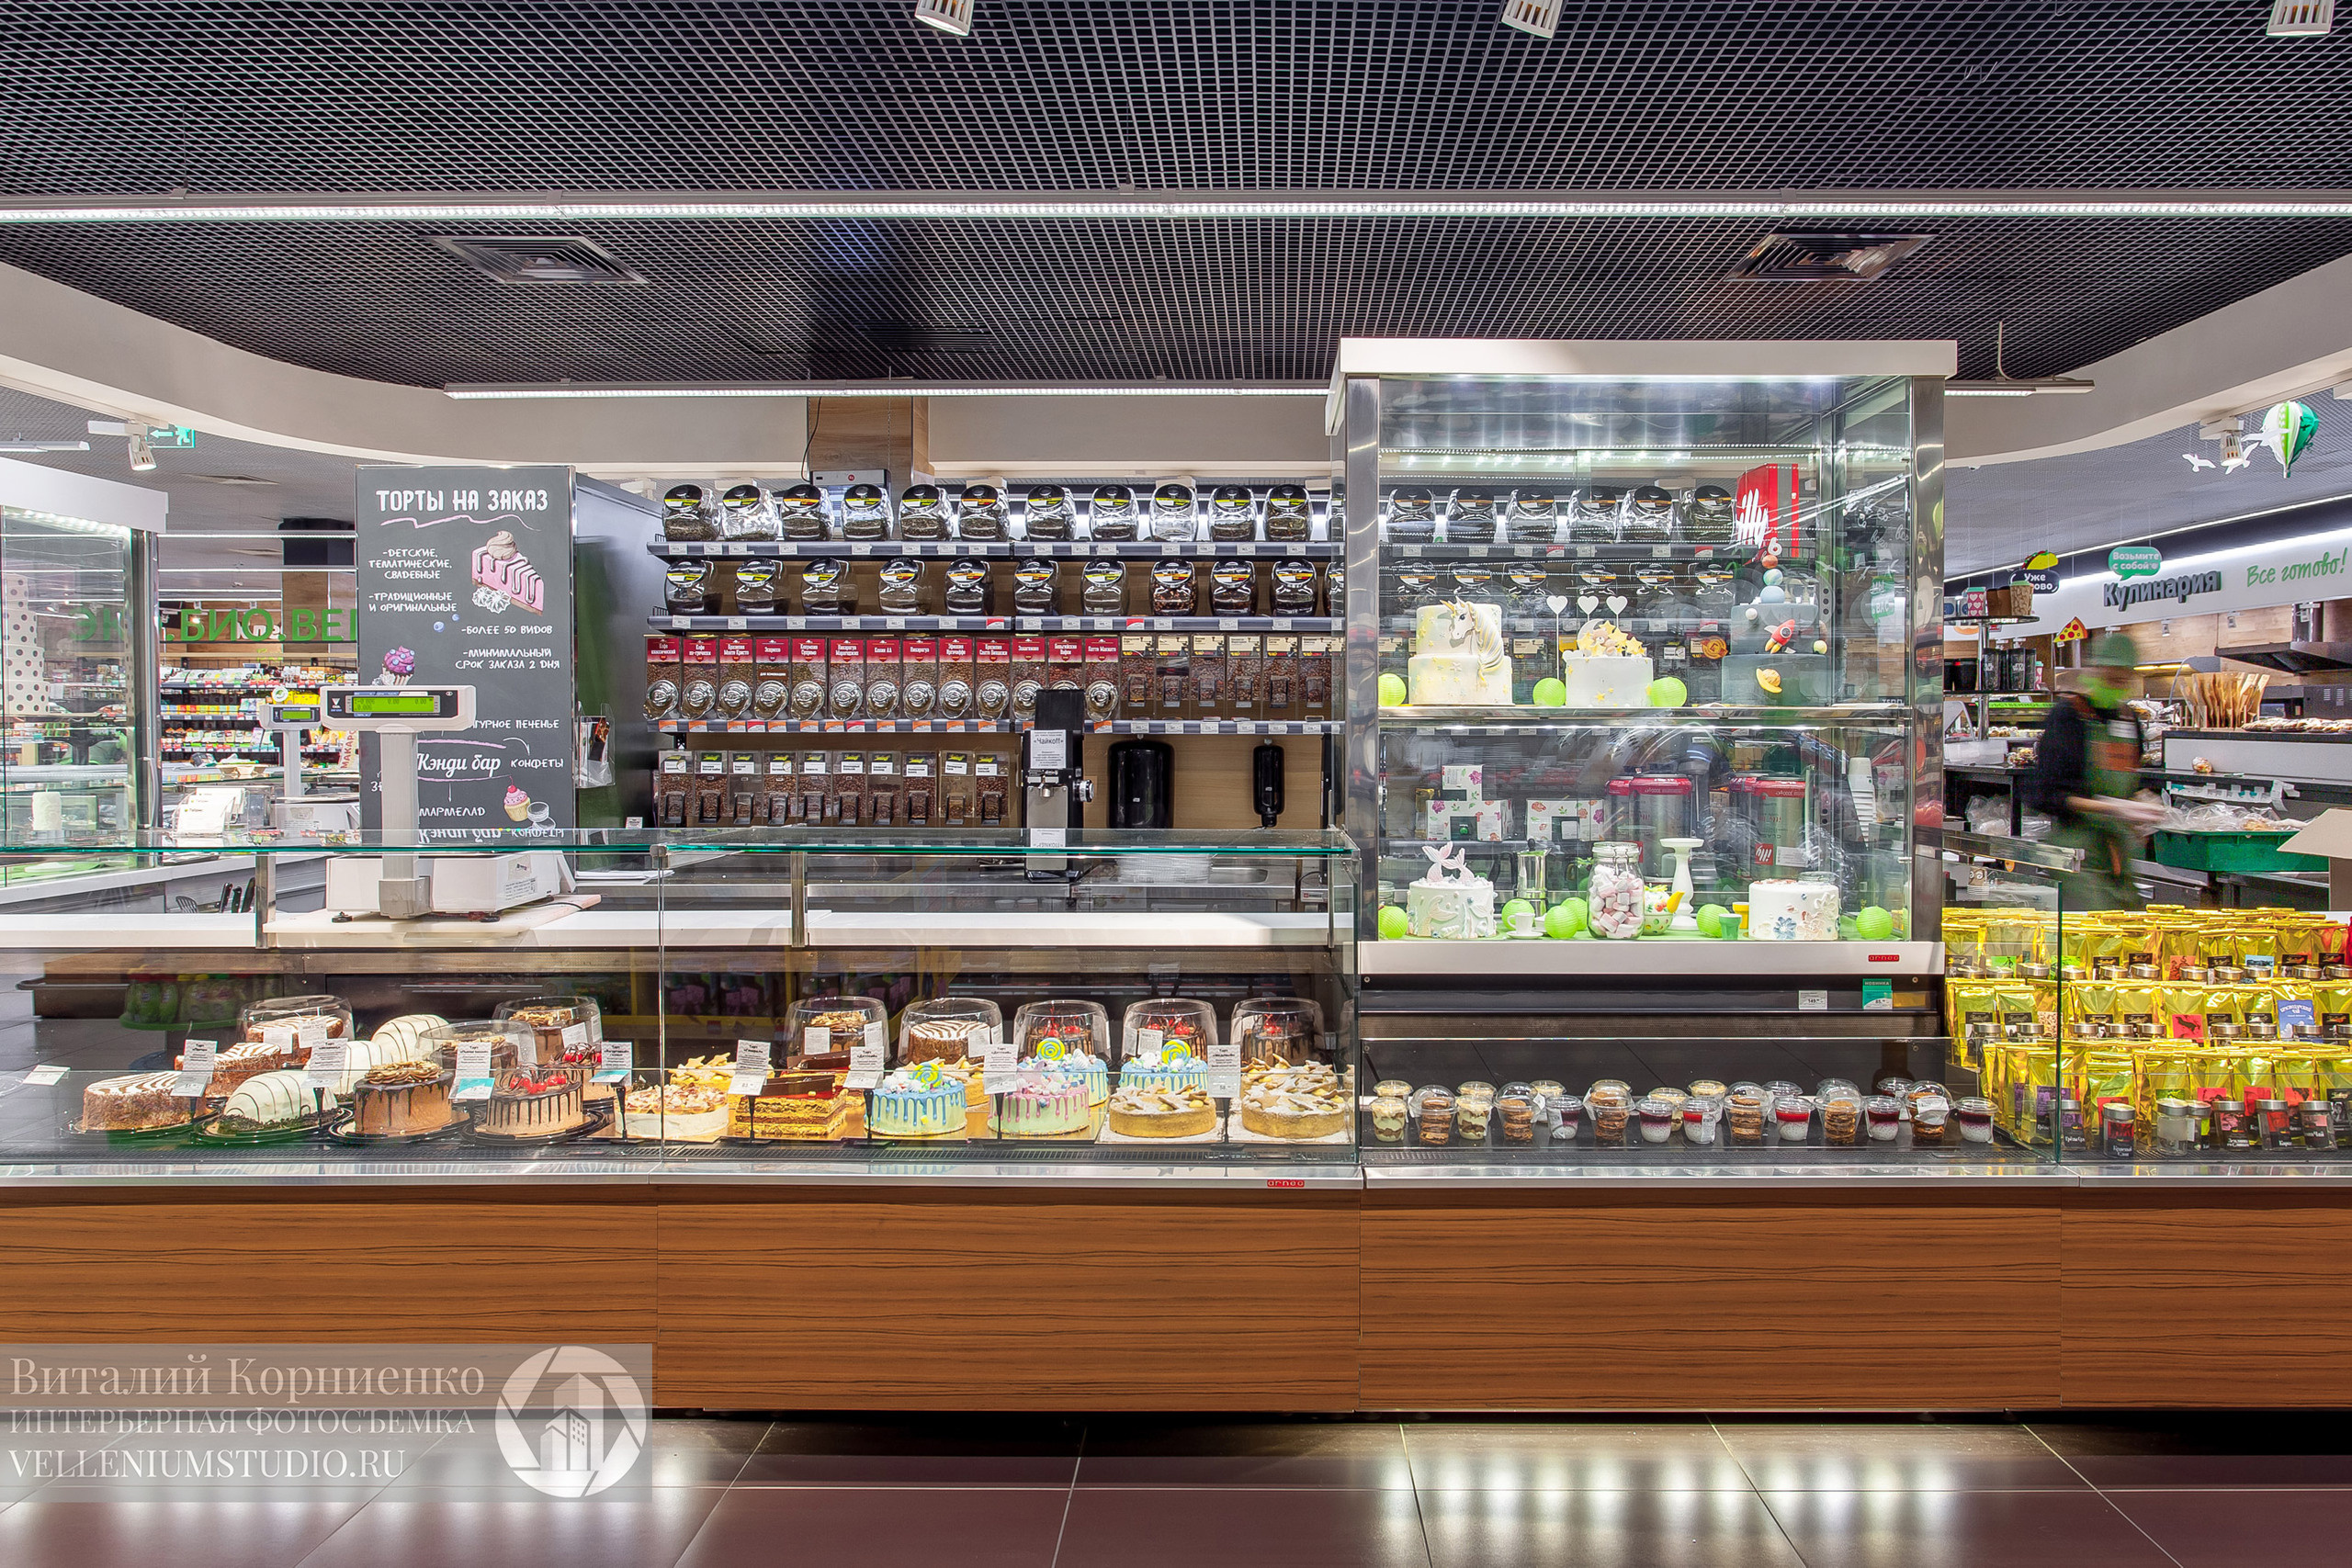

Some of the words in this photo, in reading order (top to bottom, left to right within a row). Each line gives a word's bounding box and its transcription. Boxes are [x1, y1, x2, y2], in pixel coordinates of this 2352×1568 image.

[375, 489, 445, 512] ТОРТЫ
[452, 489, 480, 512] НА
[487, 488, 549, 512] ЗАКАЗ
[2112, 551, 2160, 560] Возьмите
[368, 558, 453, 570] ТЕМАТИЧЕСКИЕ,
[2120, 560, 2149, 570] собой
[2246, 565, 2276, 587] Все
[2281, 547, 2347, 581] готово!
[384, 570, 441, 581] СВАДЕБНЫЕ
[2024, 572, 2046, 582] Уже
[2034, 582, 2053, 591] ово
[2103, 570, 2222, 613] Кулинария
[368, 603, 377, 613] И
[379, 602, 458, 613] ОРИГИНАЛЬНЫЕ
[503, 625, 517, 635] 50
[520, 625, 553, 636] ВИДОВ
[455, 659, 485, 670] СРОК
[488, 659, 526, 670] ЗАКАЗА
[528, 659, 537, 669] 2
[539, 659, 560, 670] ДНЯ
[471, 718, 513, 729] ГУРНОЕ
[515, 718, 560, 729] ПЕЧЕНЬЕ
[417, 752, 468, 781] Кэнди
[471, 750, 502, 778] бар
[510, 757, 564, 770] КОНФЕТЫ
[419, 806, 486, 818] МАРМЕЛАД
